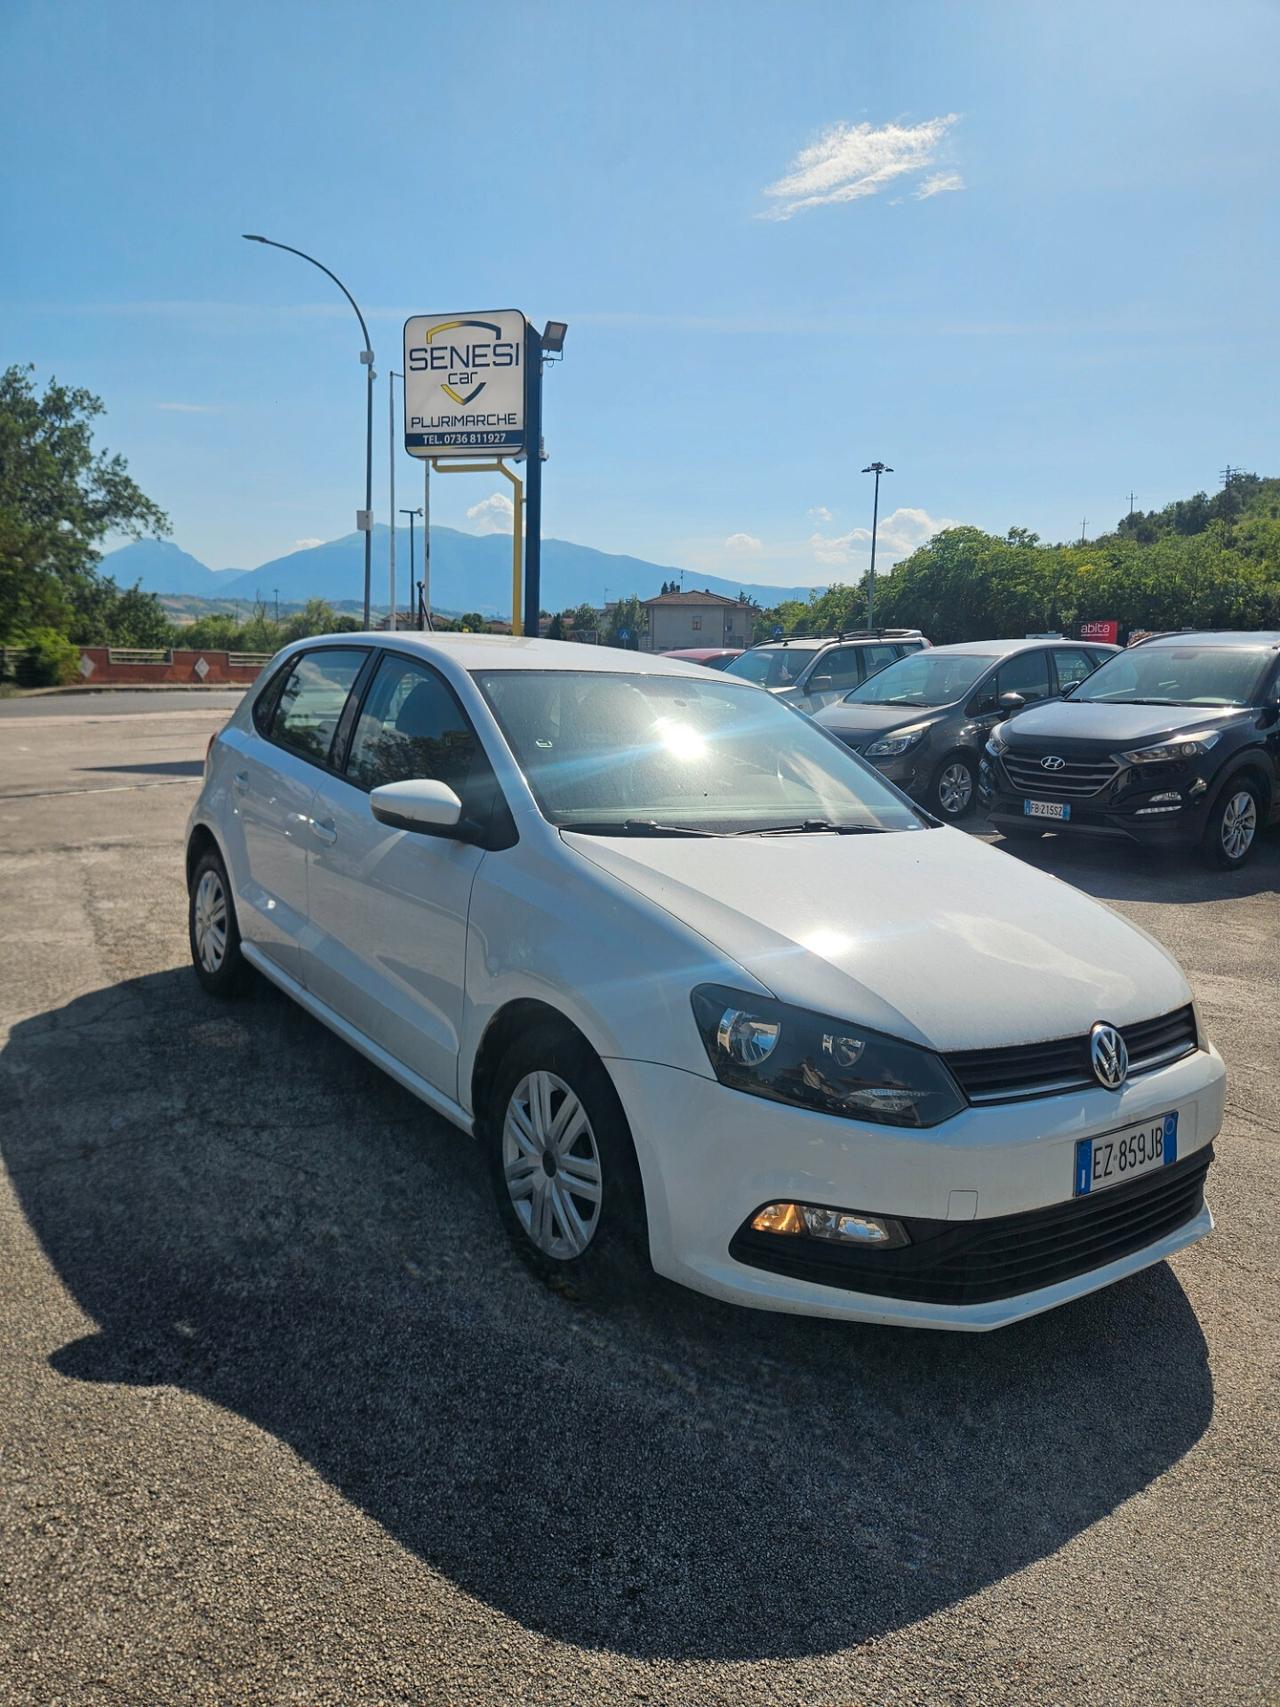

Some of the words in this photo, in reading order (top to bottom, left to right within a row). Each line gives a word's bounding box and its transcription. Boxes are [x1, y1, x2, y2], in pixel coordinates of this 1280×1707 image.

[409, 342, 520, 371] SENESI
[447, 371, 478, 385] car
[411, 413, 517, 428] PLURIMARCHE
[423, 435, 443, 445] TEL.
[444, 434, 468, 444] 0736
[470, 433, 506, 443] 811927
[1081, 623, 1110, 633] abita
